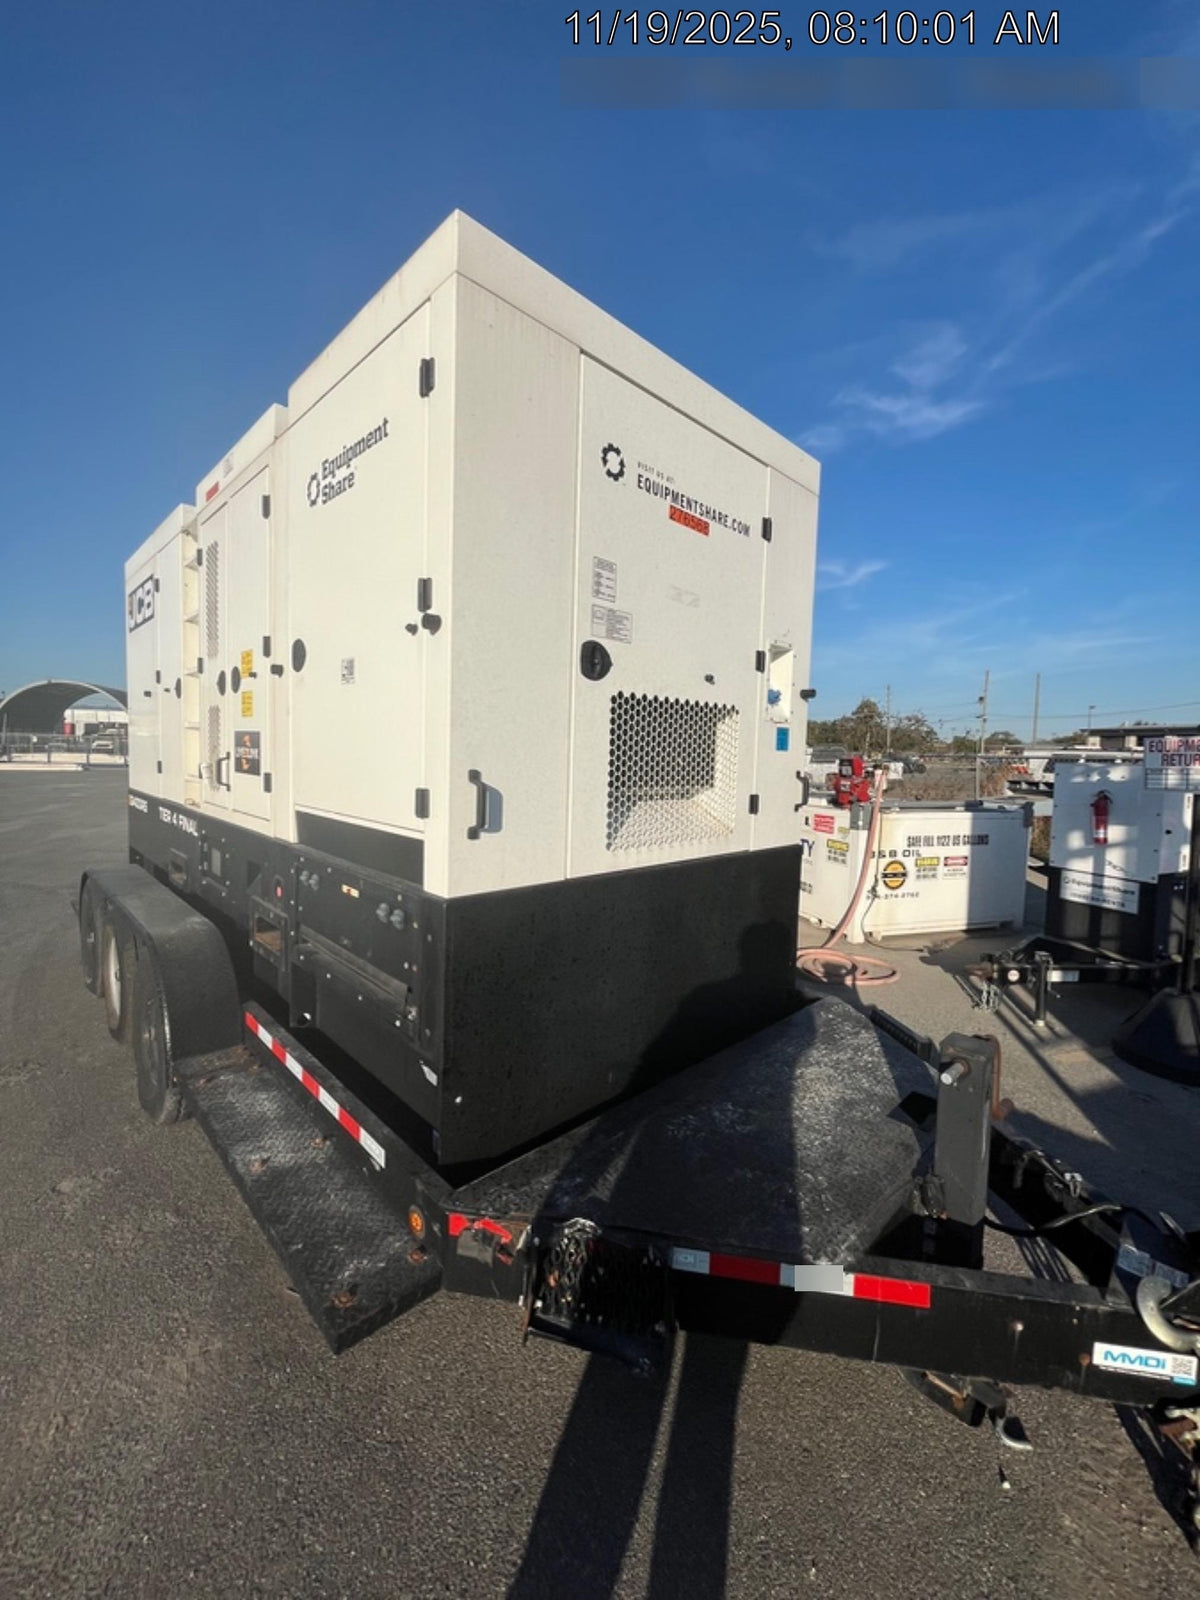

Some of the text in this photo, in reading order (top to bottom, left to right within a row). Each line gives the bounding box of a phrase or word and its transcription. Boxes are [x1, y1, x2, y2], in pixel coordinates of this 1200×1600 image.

[321, 417, 389, 481] Equipment
[321, 472, 355, 505] Share
[637, 473, 751, 538] EQUIPMENTSHARE.COM
